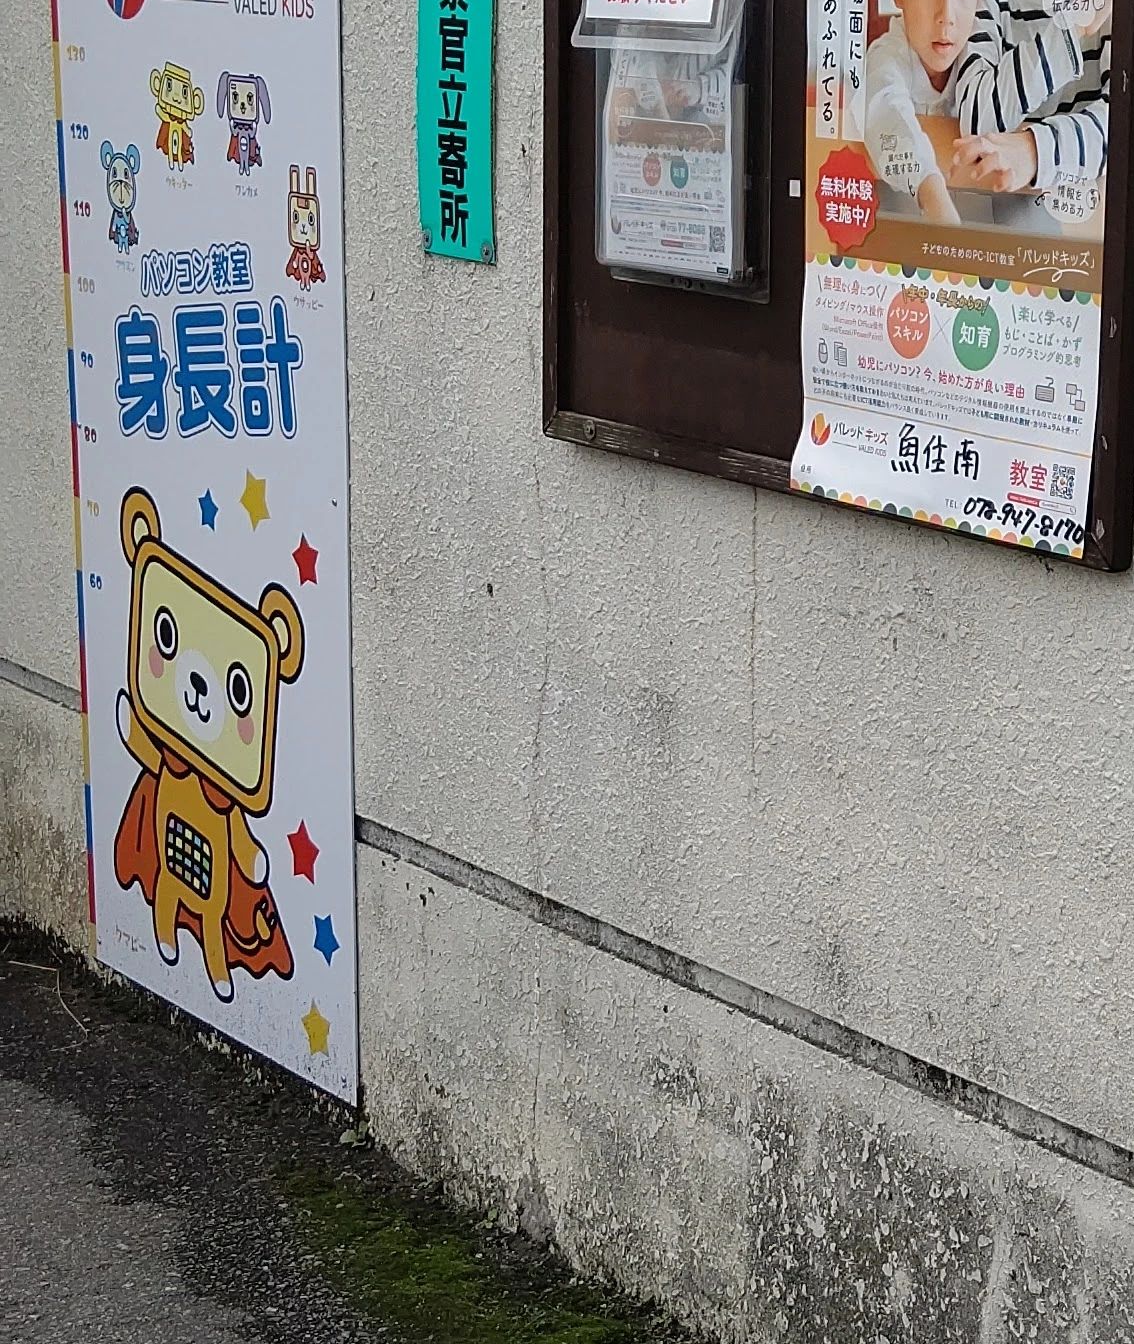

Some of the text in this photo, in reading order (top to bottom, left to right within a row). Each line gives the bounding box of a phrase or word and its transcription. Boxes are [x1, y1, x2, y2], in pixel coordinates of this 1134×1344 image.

[66, 45, 86, 62] 130
[70, 122, 89, 141] 120
[884, 161, 921, 177] 表現する力
[1055, 170, 1089, 186] パソコンで
[820, 174, 873, 202] 無料体験
[1057, 185, 1083, 202] 情報を
[73, 199, 91, 218] 110
[825, 200, 871, 228] 実施中!
[1051, 198, 1085, 219] 集める力
[141, 242, 253, 297] パソコン教室
[77, 276, 96, 294] 100
[889, 307, 929, 324] パソコン
[1018, 305, 1073, 330] 楽しく学べる
[893, 325, 924, 342] スキル
[958, 321, 992, 349] 知育
[1004, 326, 1083, 352] もじ・ことば・かず
[81, 351, 94, 369] 90
[1002, 345, 1082, 368] プログラミング的思考
[115, 295, 304, 441] 身長計
[84, 426, 97, 443] 80
[890, 422, 980, 481] 魚住南
[1009, 458, 1048, 492] 教室
[87, 499, 100, 517] 70
[963, 496, 1086, 545] 078-947-8170
[89, 572, 102, 590] 60
